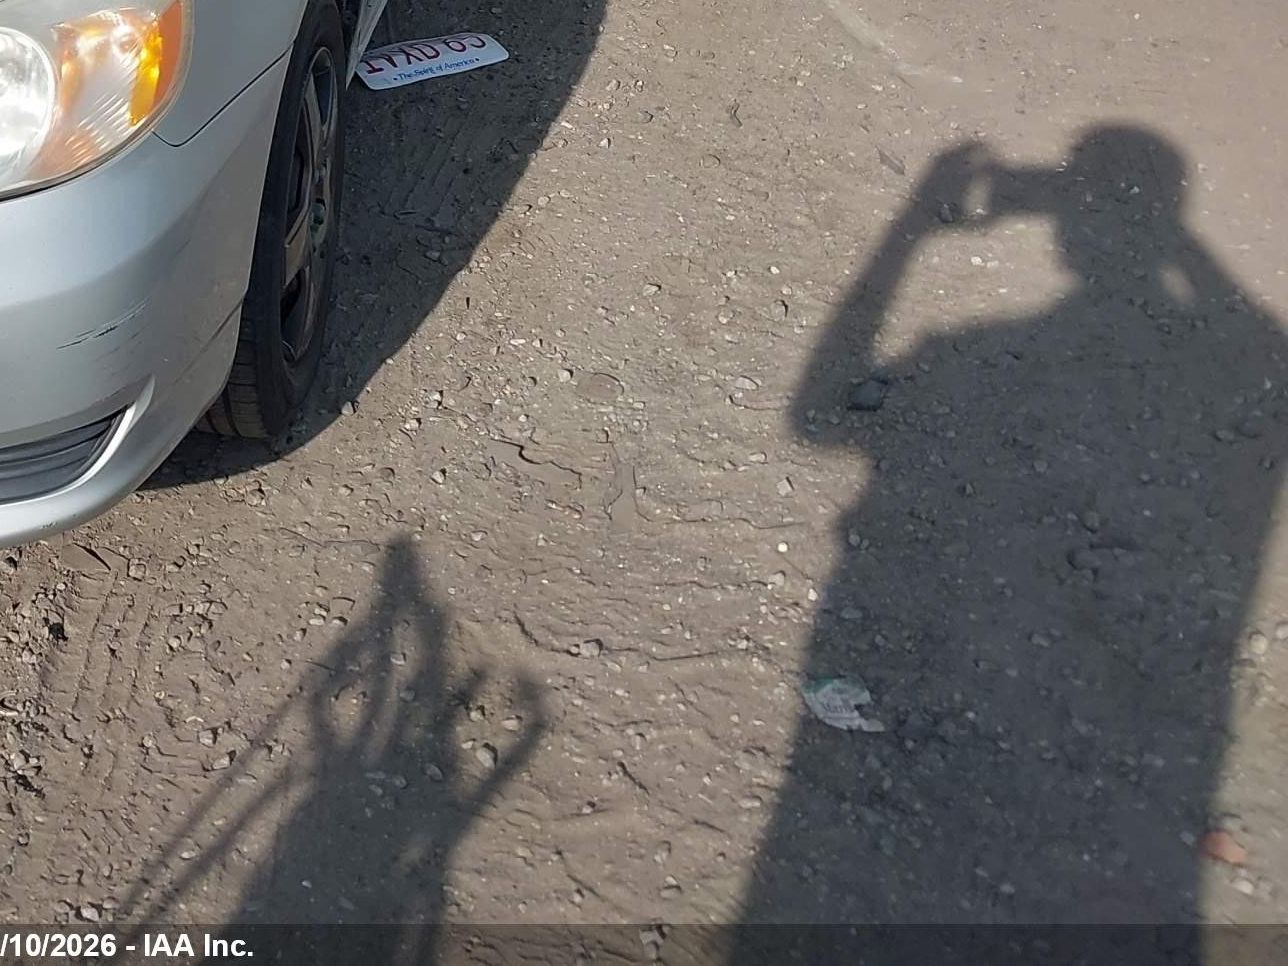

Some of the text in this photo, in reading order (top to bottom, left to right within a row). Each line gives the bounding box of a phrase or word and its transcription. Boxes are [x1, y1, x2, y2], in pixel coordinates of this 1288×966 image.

[397, 73, 413, 81] The
[413, 66, 436, 76] Spirit
[444, 59, 475, 70] America
